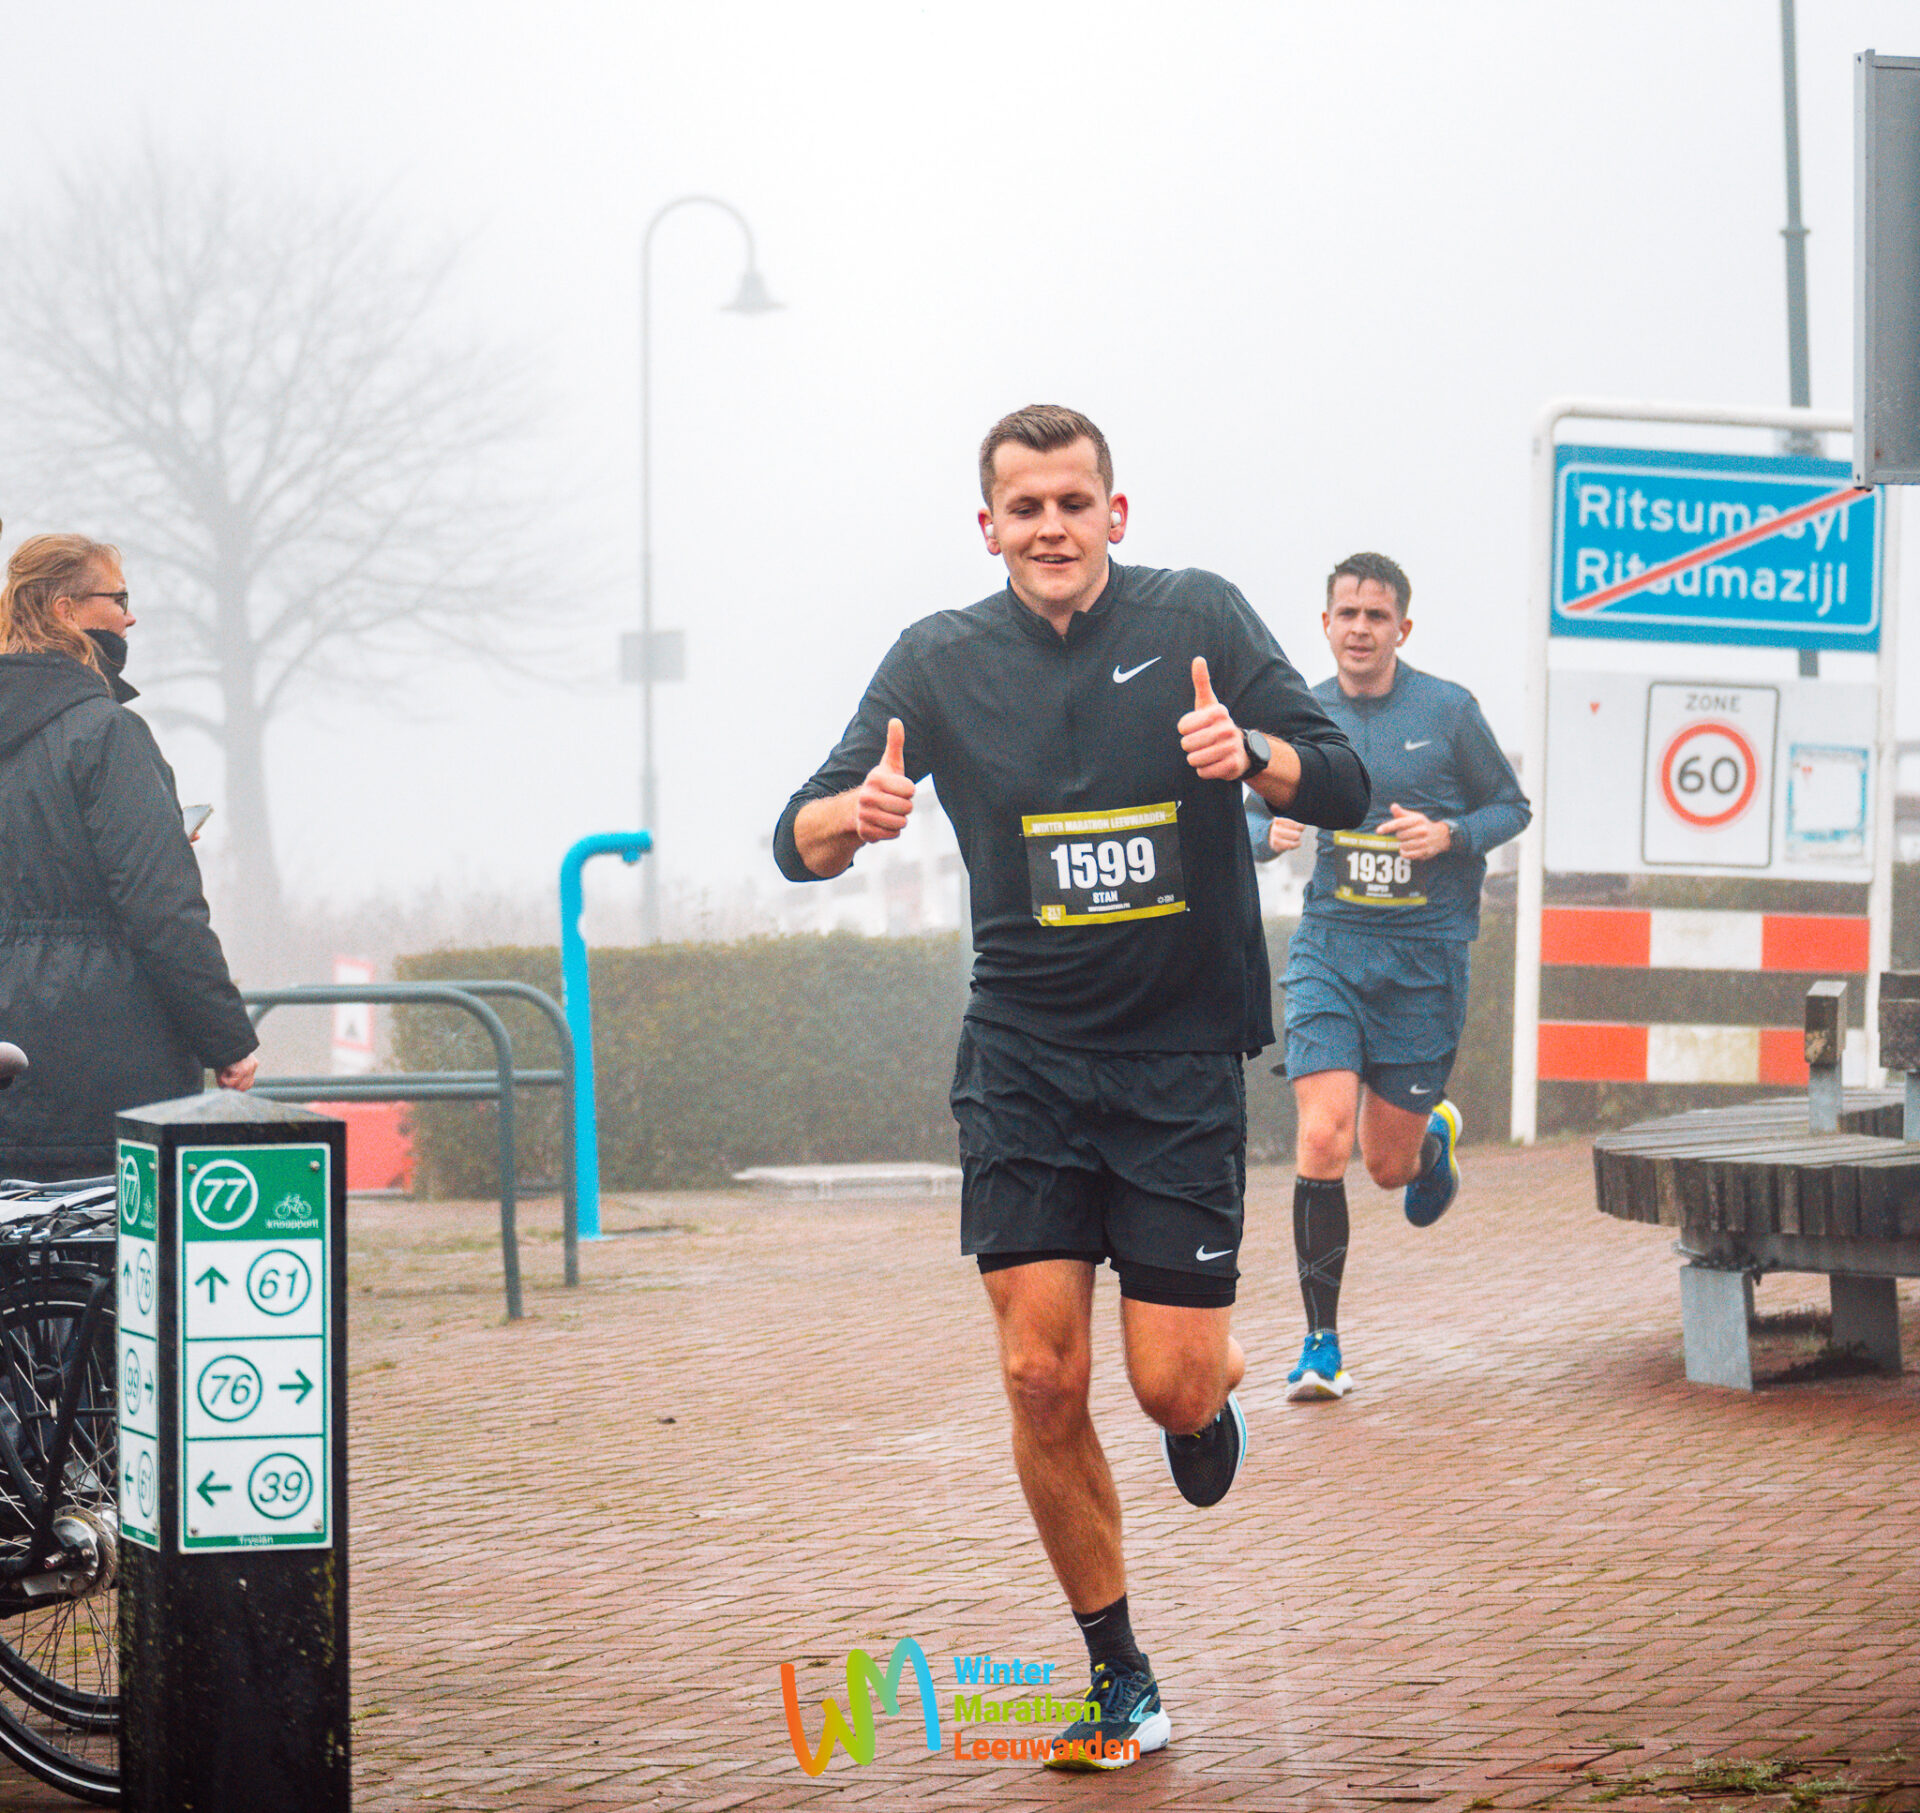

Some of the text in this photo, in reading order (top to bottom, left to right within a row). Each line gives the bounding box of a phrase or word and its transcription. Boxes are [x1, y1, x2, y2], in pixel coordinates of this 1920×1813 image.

[1685, 694, 1742, 713] ZONE
[1677, 756, 1740, 794] 60
[1031, 811, 1166, 834] WINTER MARATHON LEEUWARDEN
[1050, 836, 1156, 890] 1599
[1346, 851, 1412, 884] 1936
[1092, 890, 1119, 904] STAN
[203, 1178, 248, 1212] 77
[258, 1269, 298, 1300] 61
[211, 1374, 253, 1405] 76
[259, 1471, 303, 1503] 39
